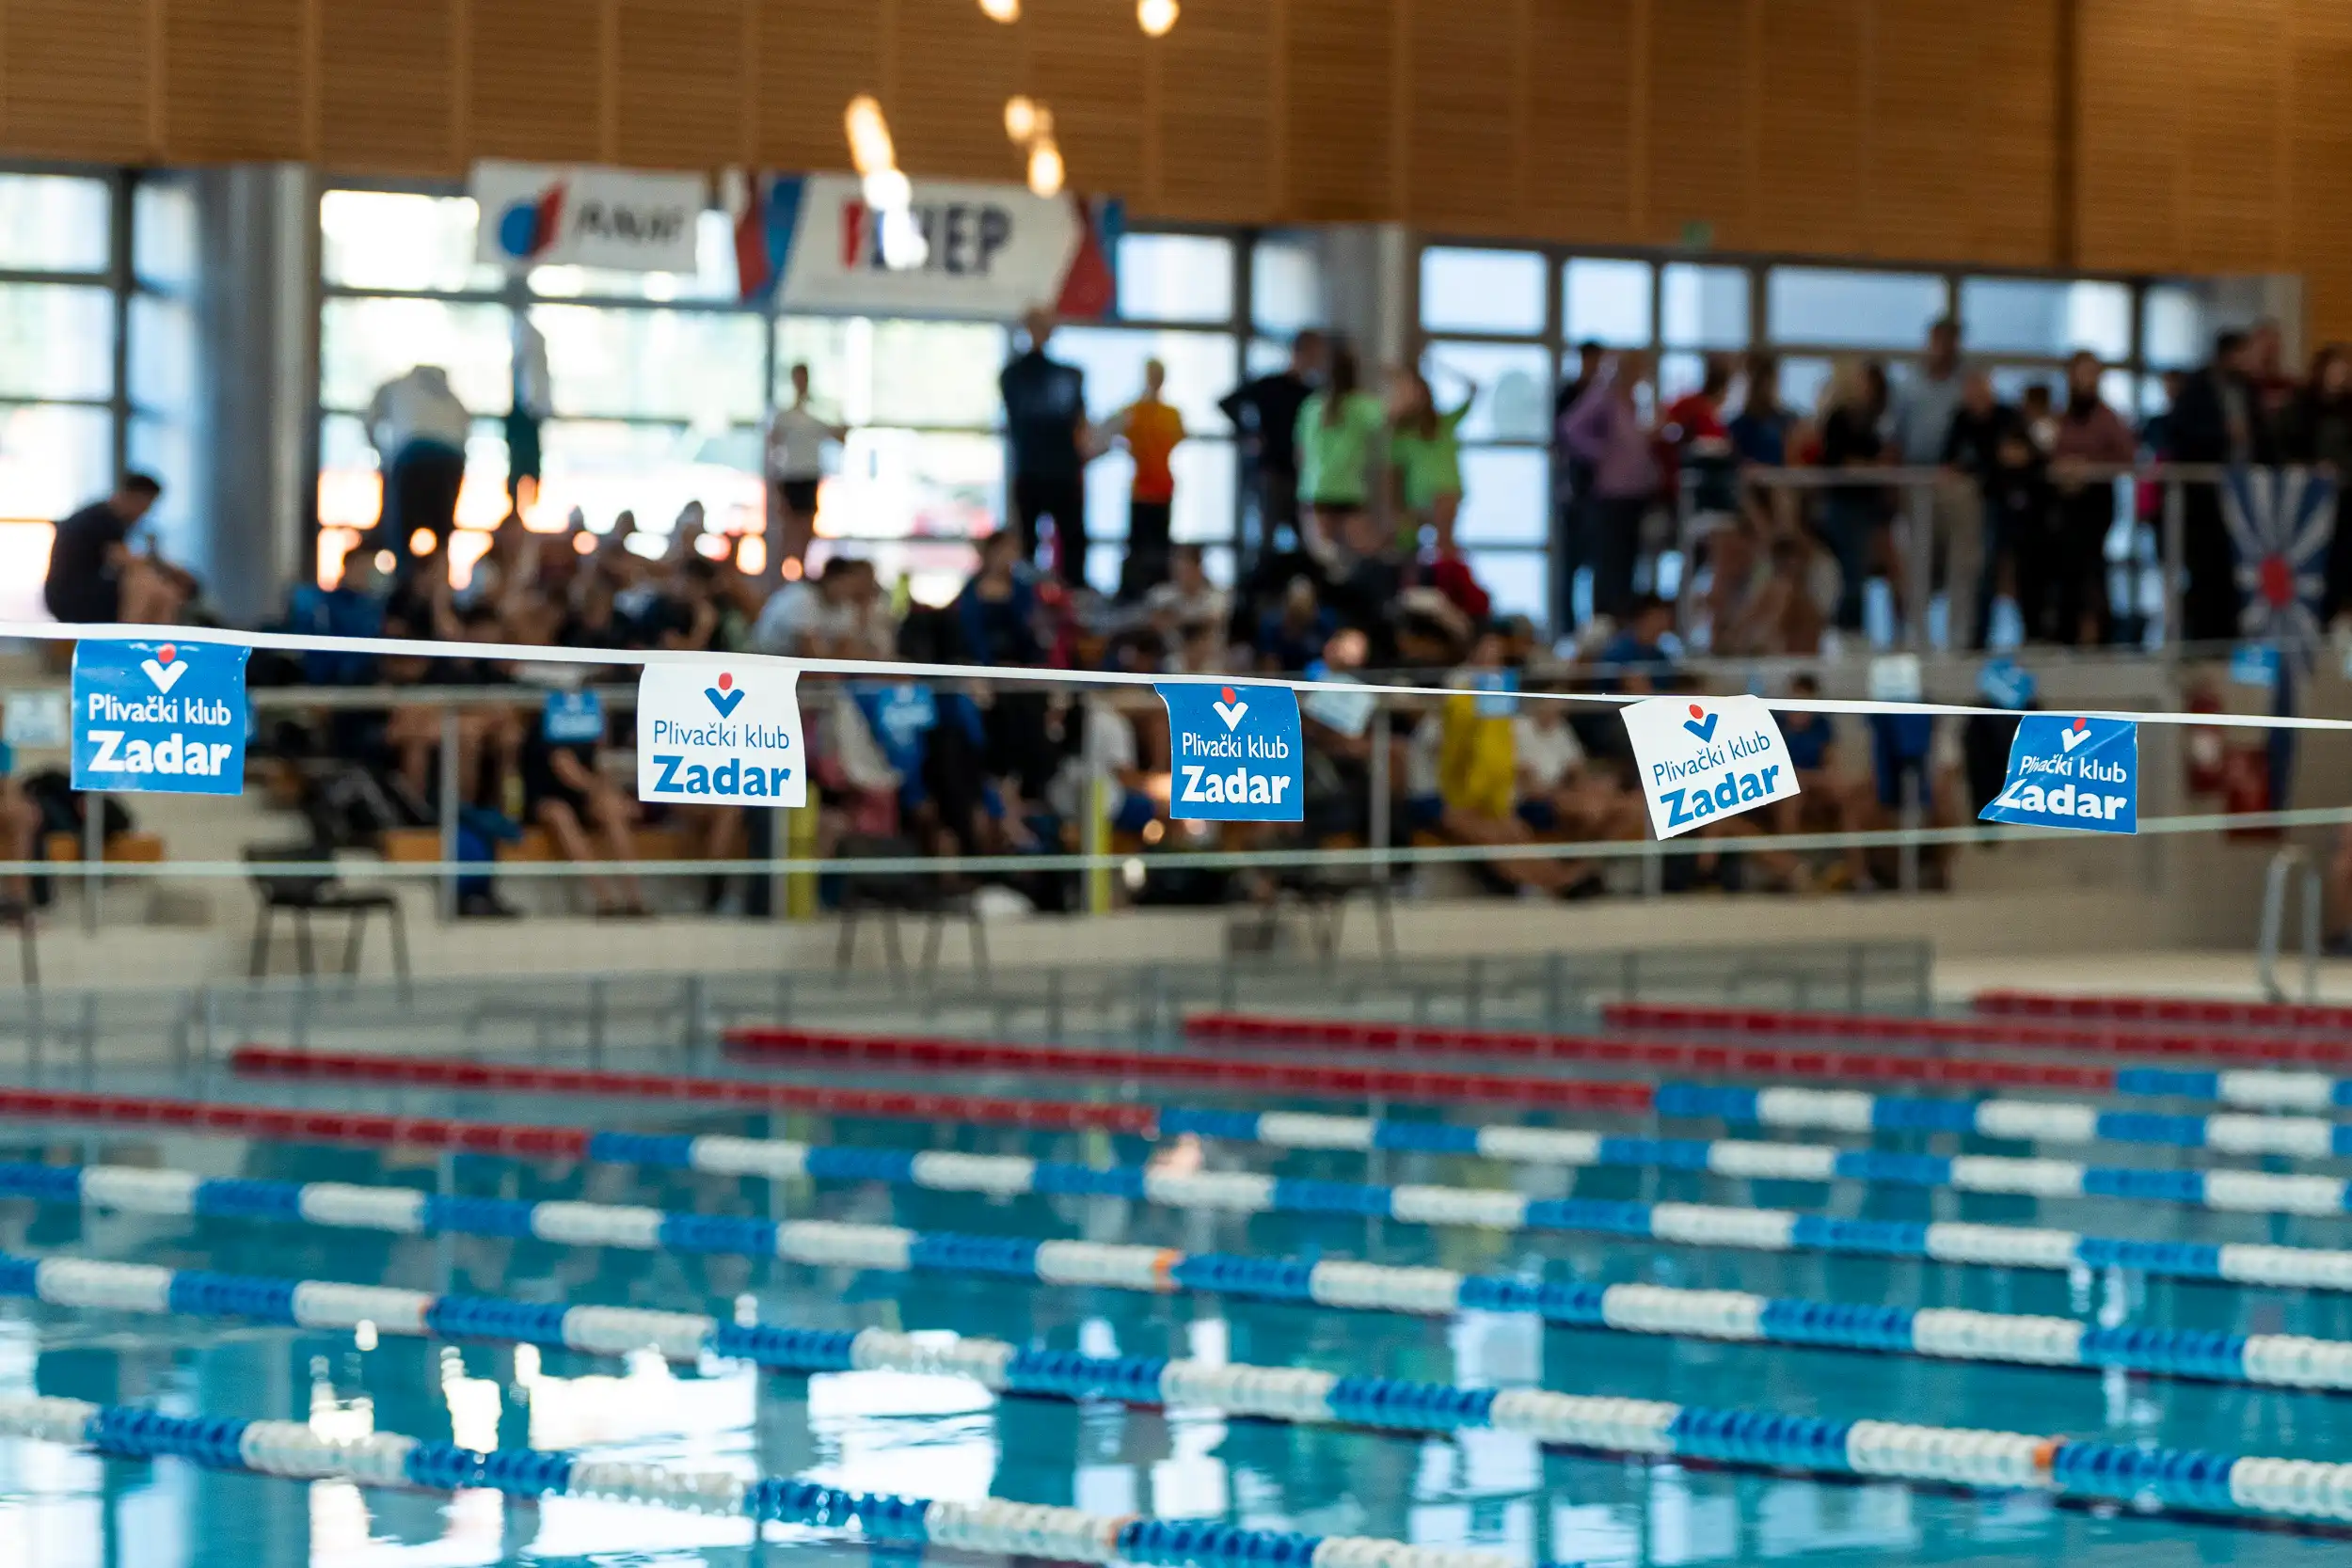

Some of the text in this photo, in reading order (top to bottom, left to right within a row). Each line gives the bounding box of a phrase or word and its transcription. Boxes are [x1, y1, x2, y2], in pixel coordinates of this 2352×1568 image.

[88, 693, 231, 726] Plivački klub
[87, 730, 232, 776] Zadar
[654, 720, 790, 749] Plivački klub
[1182, 732, 1289, 759] Plivački klub
[653, 754, 792, 797] Zadar
[1652, 730, 1771, 786] Plivački klub
[2019, 753, 2127, 784] Plivački klub
[1180, 765, 1291, 804] Zadar
[1660, 765, 1779, 829] Zadar
[1994, 778, 2128, 820] Zadar
